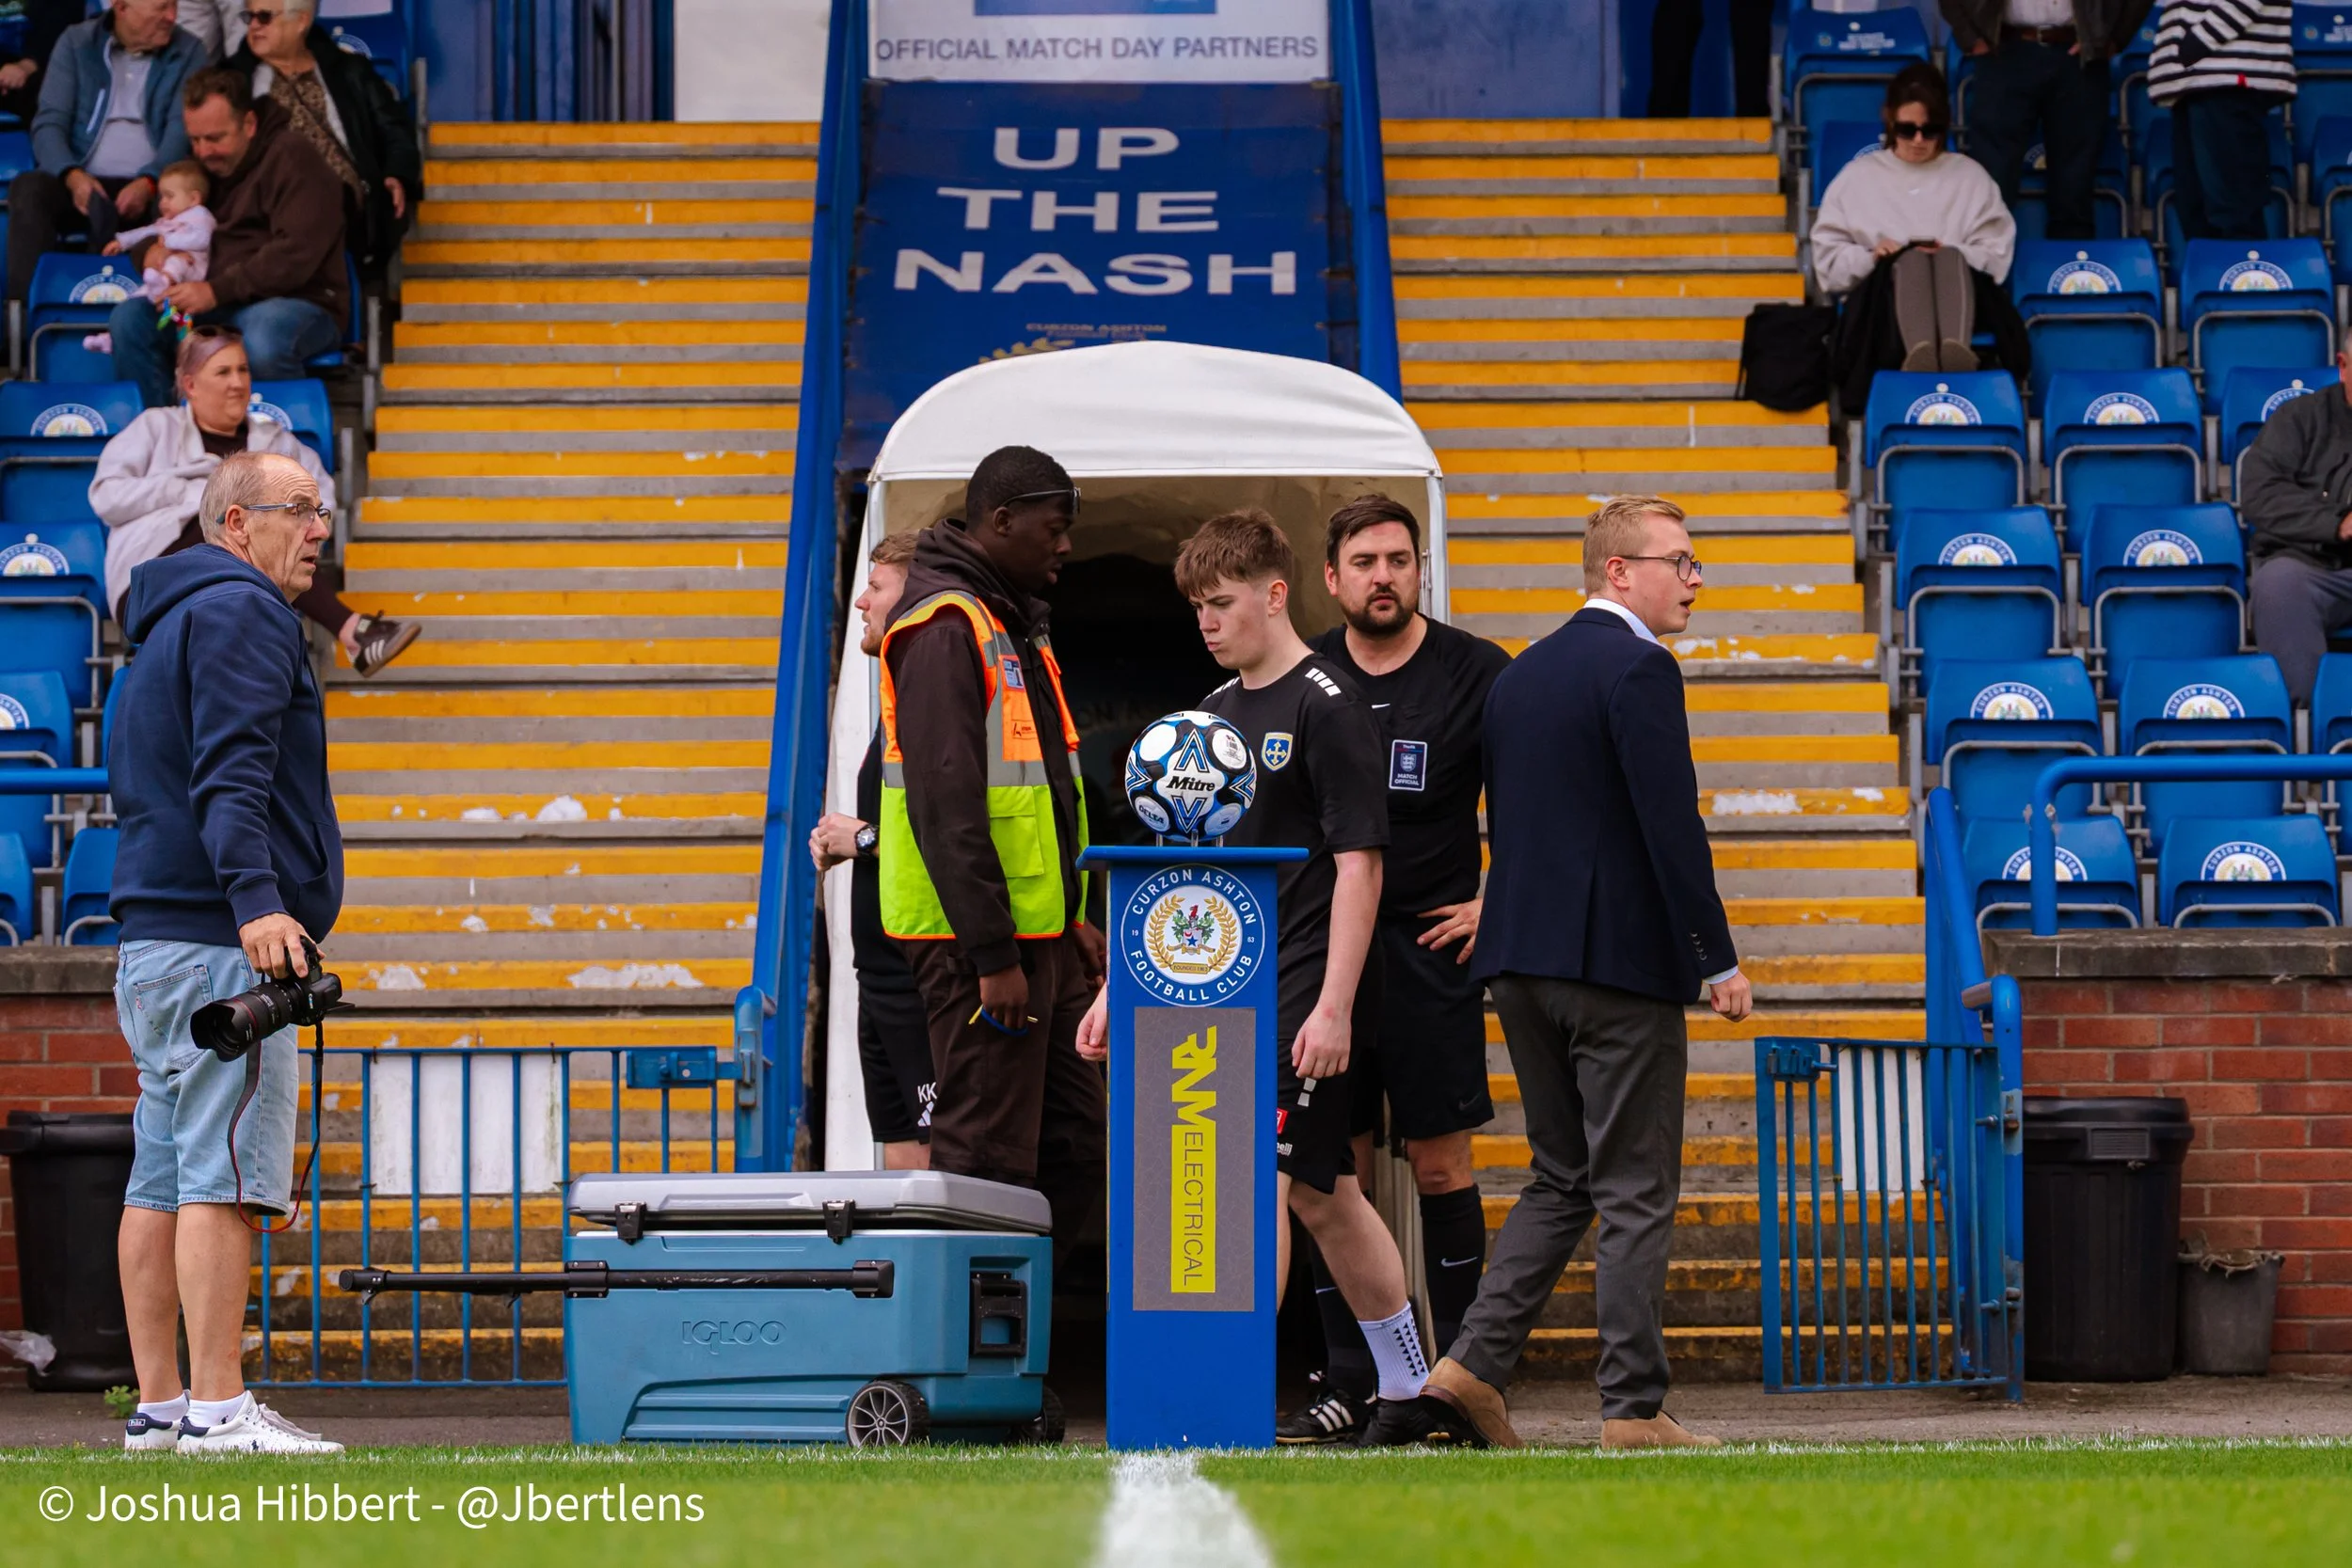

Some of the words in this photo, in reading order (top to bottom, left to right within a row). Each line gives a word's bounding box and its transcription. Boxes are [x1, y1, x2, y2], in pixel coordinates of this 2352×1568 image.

[876, 39, 998, 62] OFFICIAL
[1007, 38, 1103, 59] MATCH
[1111, 37, 1164, 58] DAY
[1173, 36, 1318, 59] PARTNERS
[993, 127, 1180, 170] UP
[937, 187, 1218, 232] THE
[894, 249, 1295, 295] NASH
[1166, 775, 1216, 792] Mitre
[1138, 804, 1165, 825] DELTA
[1132, 868, 1193, 916] CURZON
[1201, 868, 1257, 926] ASHTON
[1130, 949, 1210, 1002] FOOTBALL
[1216, 954, 1252, 994] CLUB
[1183, 1131, 1204, 1287] ELECTRICAL
[681, 1319, 787, 1355] IGLOO
